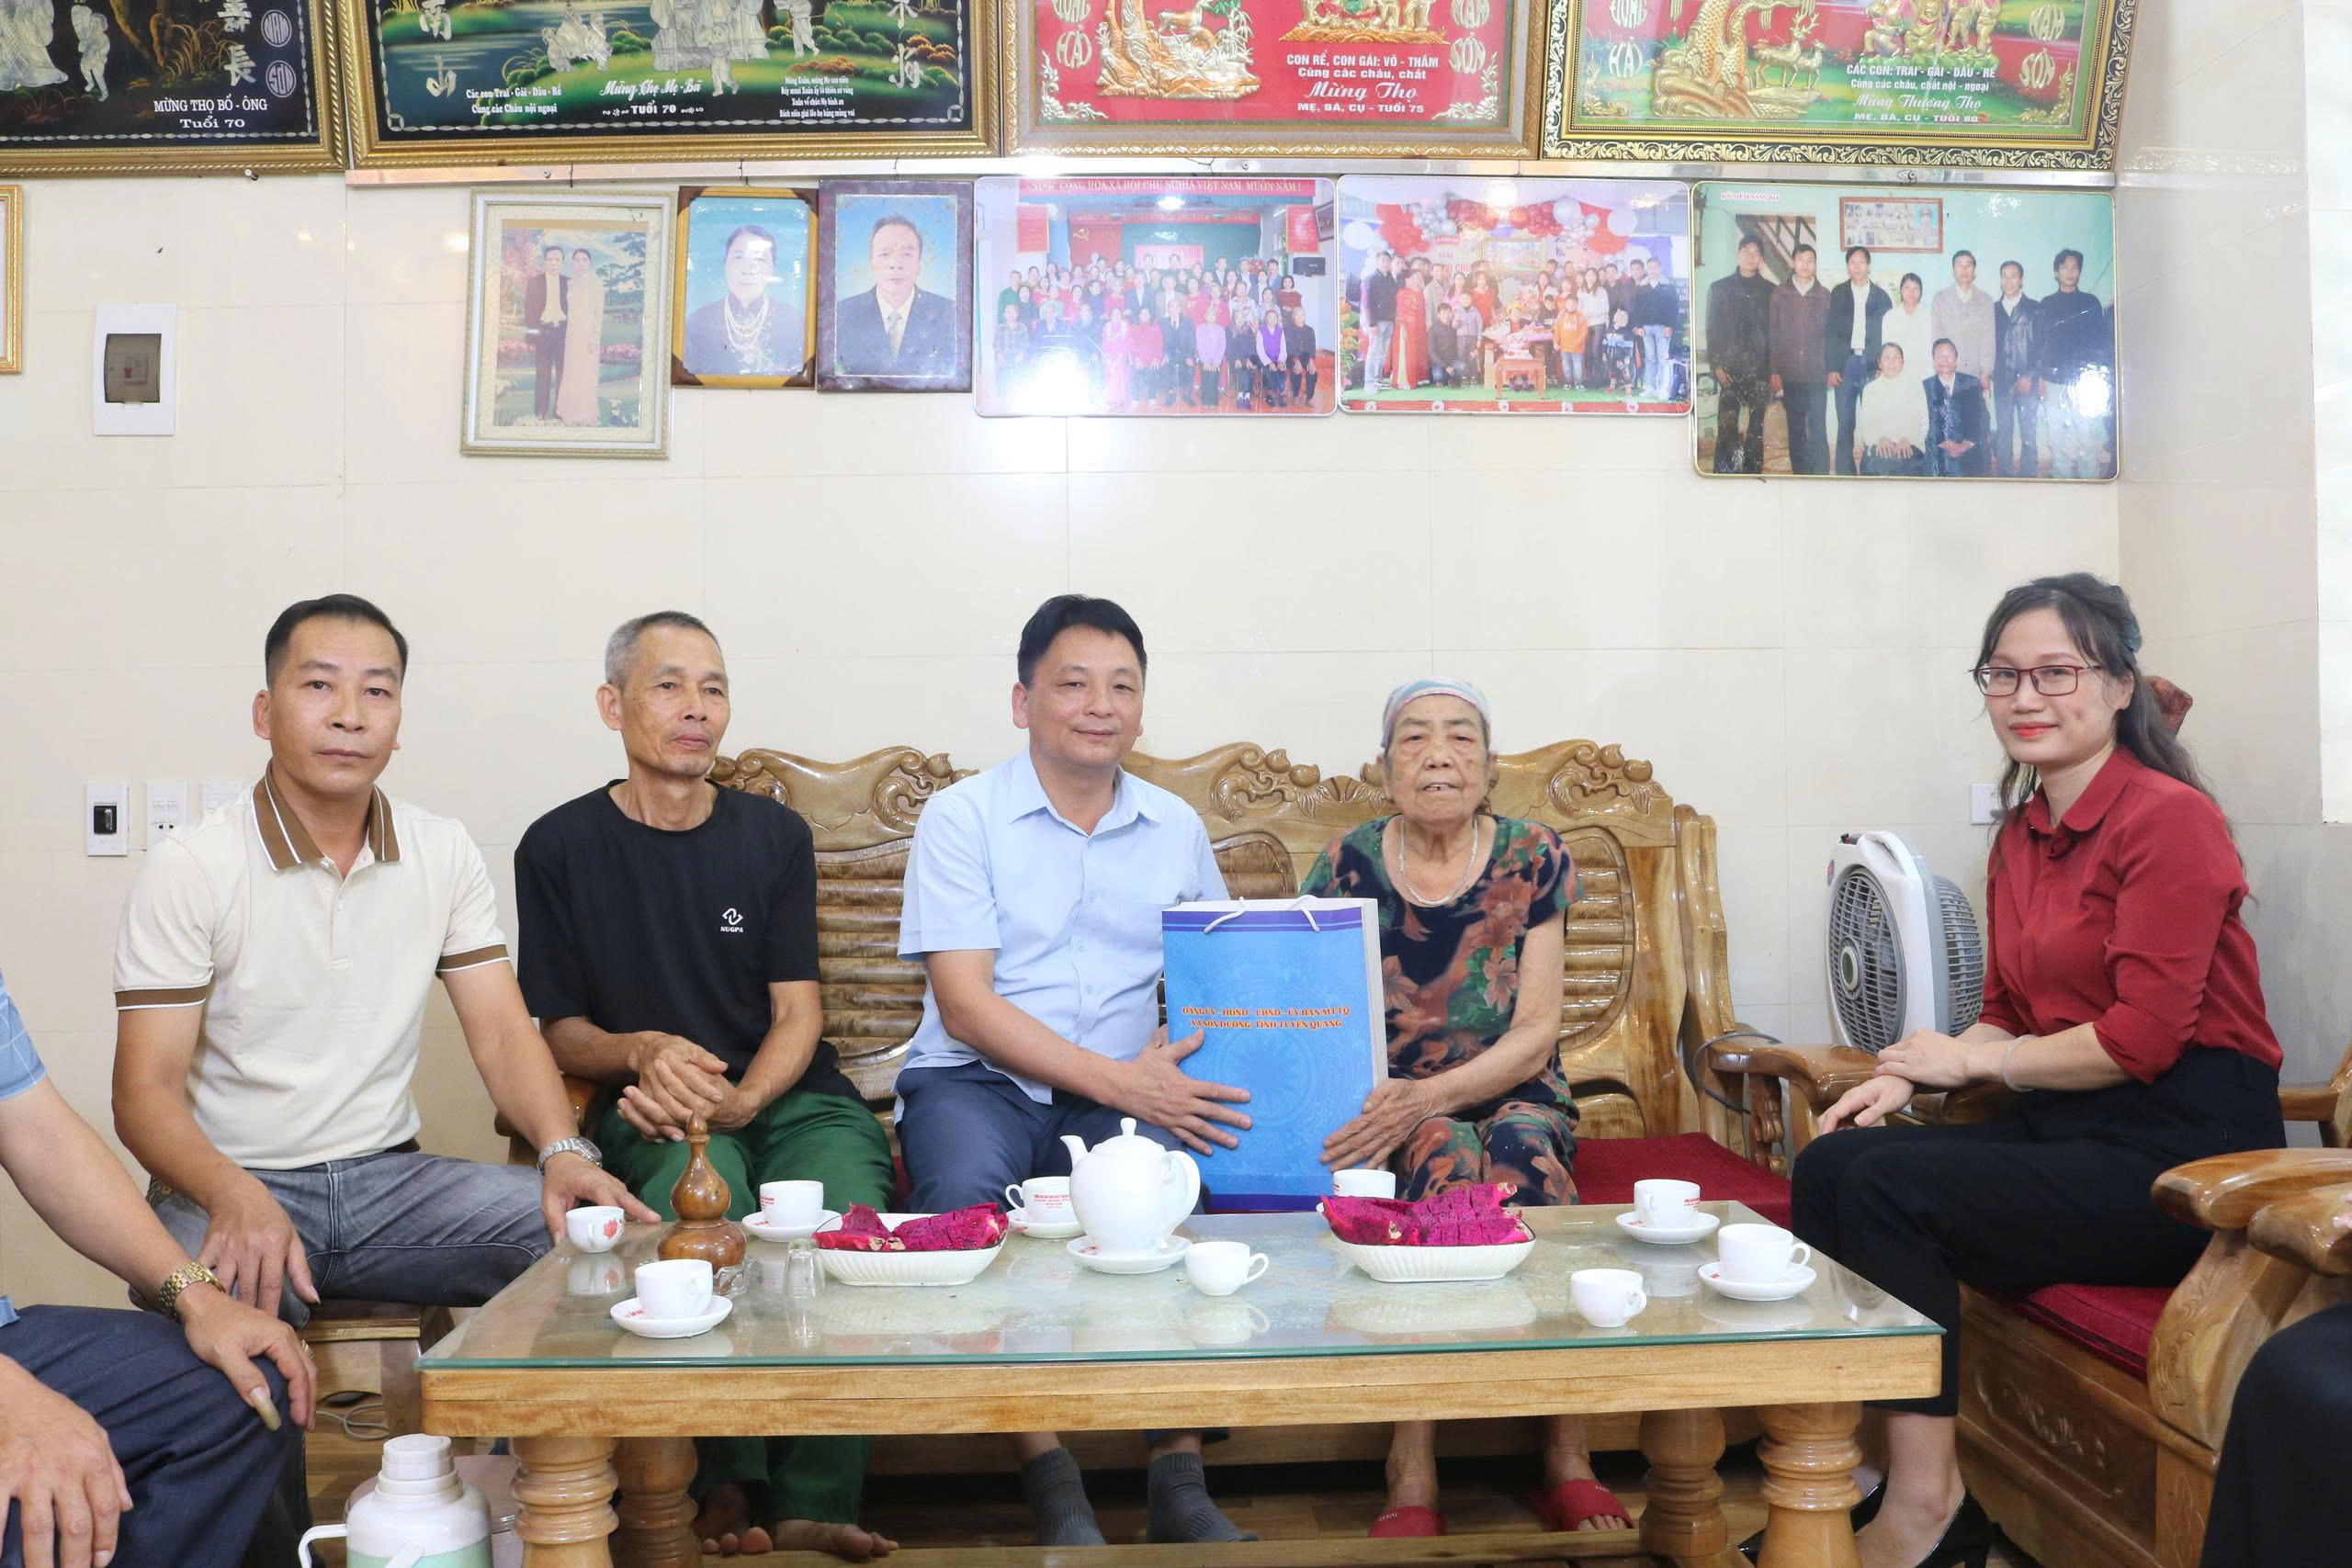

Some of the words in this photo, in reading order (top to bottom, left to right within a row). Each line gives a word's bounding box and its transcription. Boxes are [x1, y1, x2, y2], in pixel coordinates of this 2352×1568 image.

[1286, 54, 1310, 65] CON
[1333, 55, 1356, 66] CON
[1333, 68, 1357, 78] các
[1895, 65, 1917, 76] TRAI
[1375, 82, 1419, 103] Thọ
[153, 96, 188, 112] MỪNG
[190, 99, 214, 115] THỌ
[243, 96, 268, 111] ÔNG
[662, 104, 677, 113] 70
[1409, 104, 1424, 113] 75
[179, 116, 220, 129] Tuổi
[224, 118, 245, 129] 70
